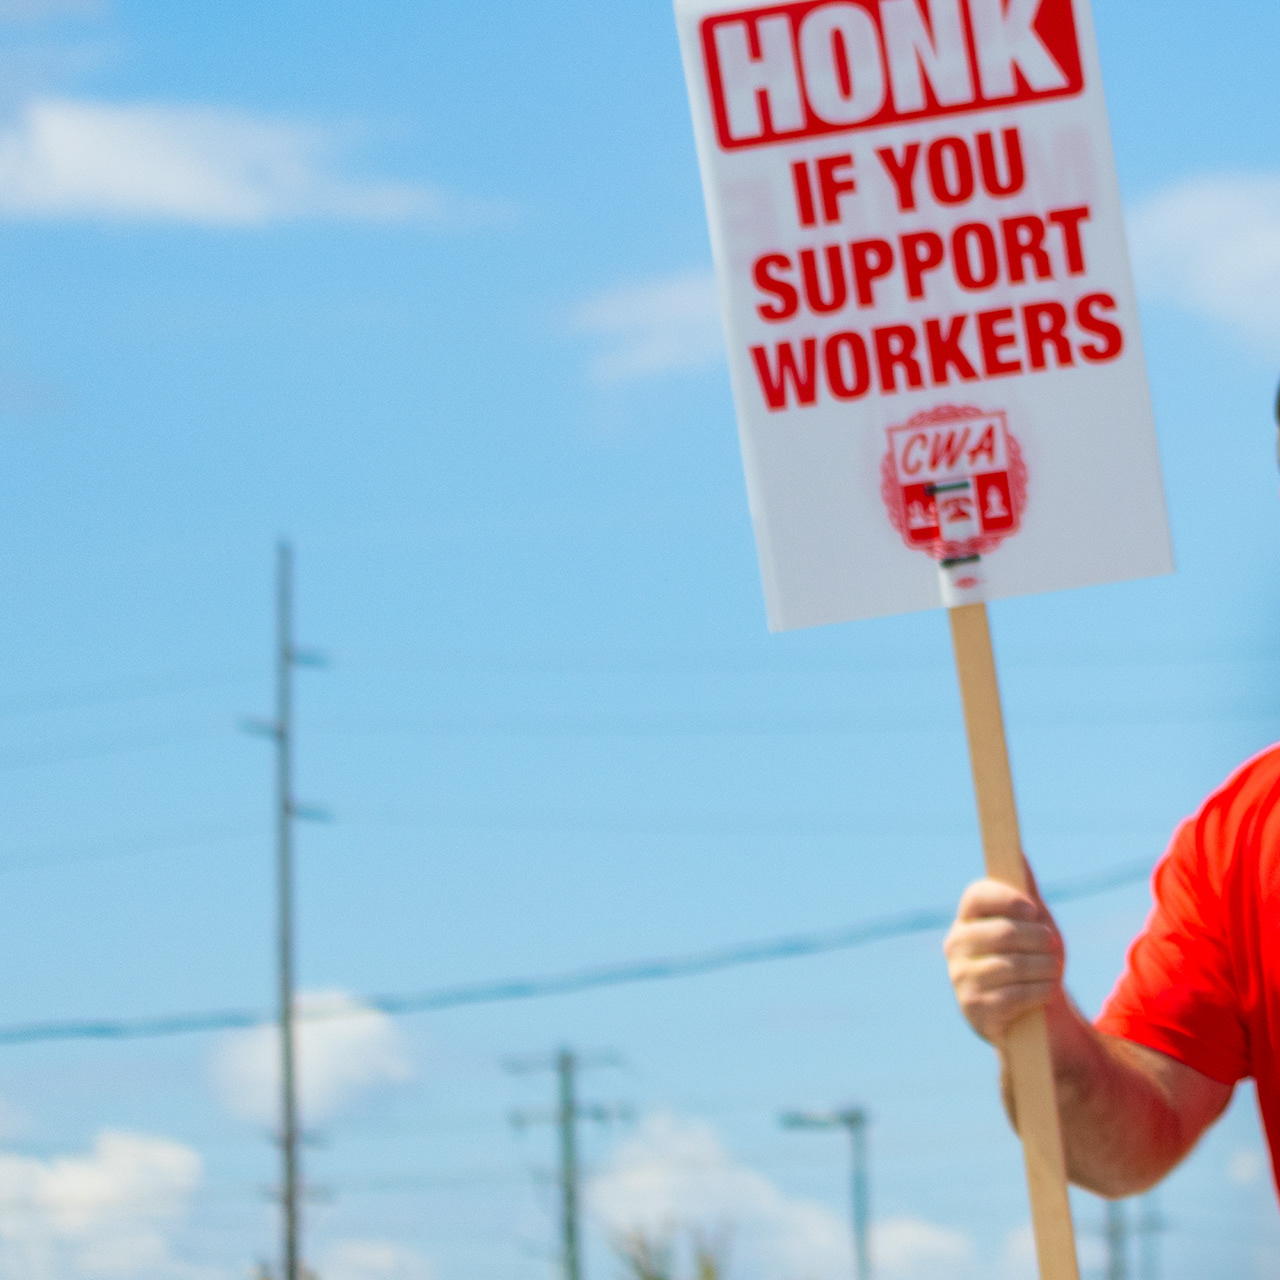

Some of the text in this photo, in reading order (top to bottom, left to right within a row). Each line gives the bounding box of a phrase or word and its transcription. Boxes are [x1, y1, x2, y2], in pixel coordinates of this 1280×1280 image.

[790, 126, 1025, 228] IF YOU
[751, 206, 1091, 324] SUPPORT
[751, 291, 1124, 413] WORKERS
[902, 424, 995, 476] CWA
